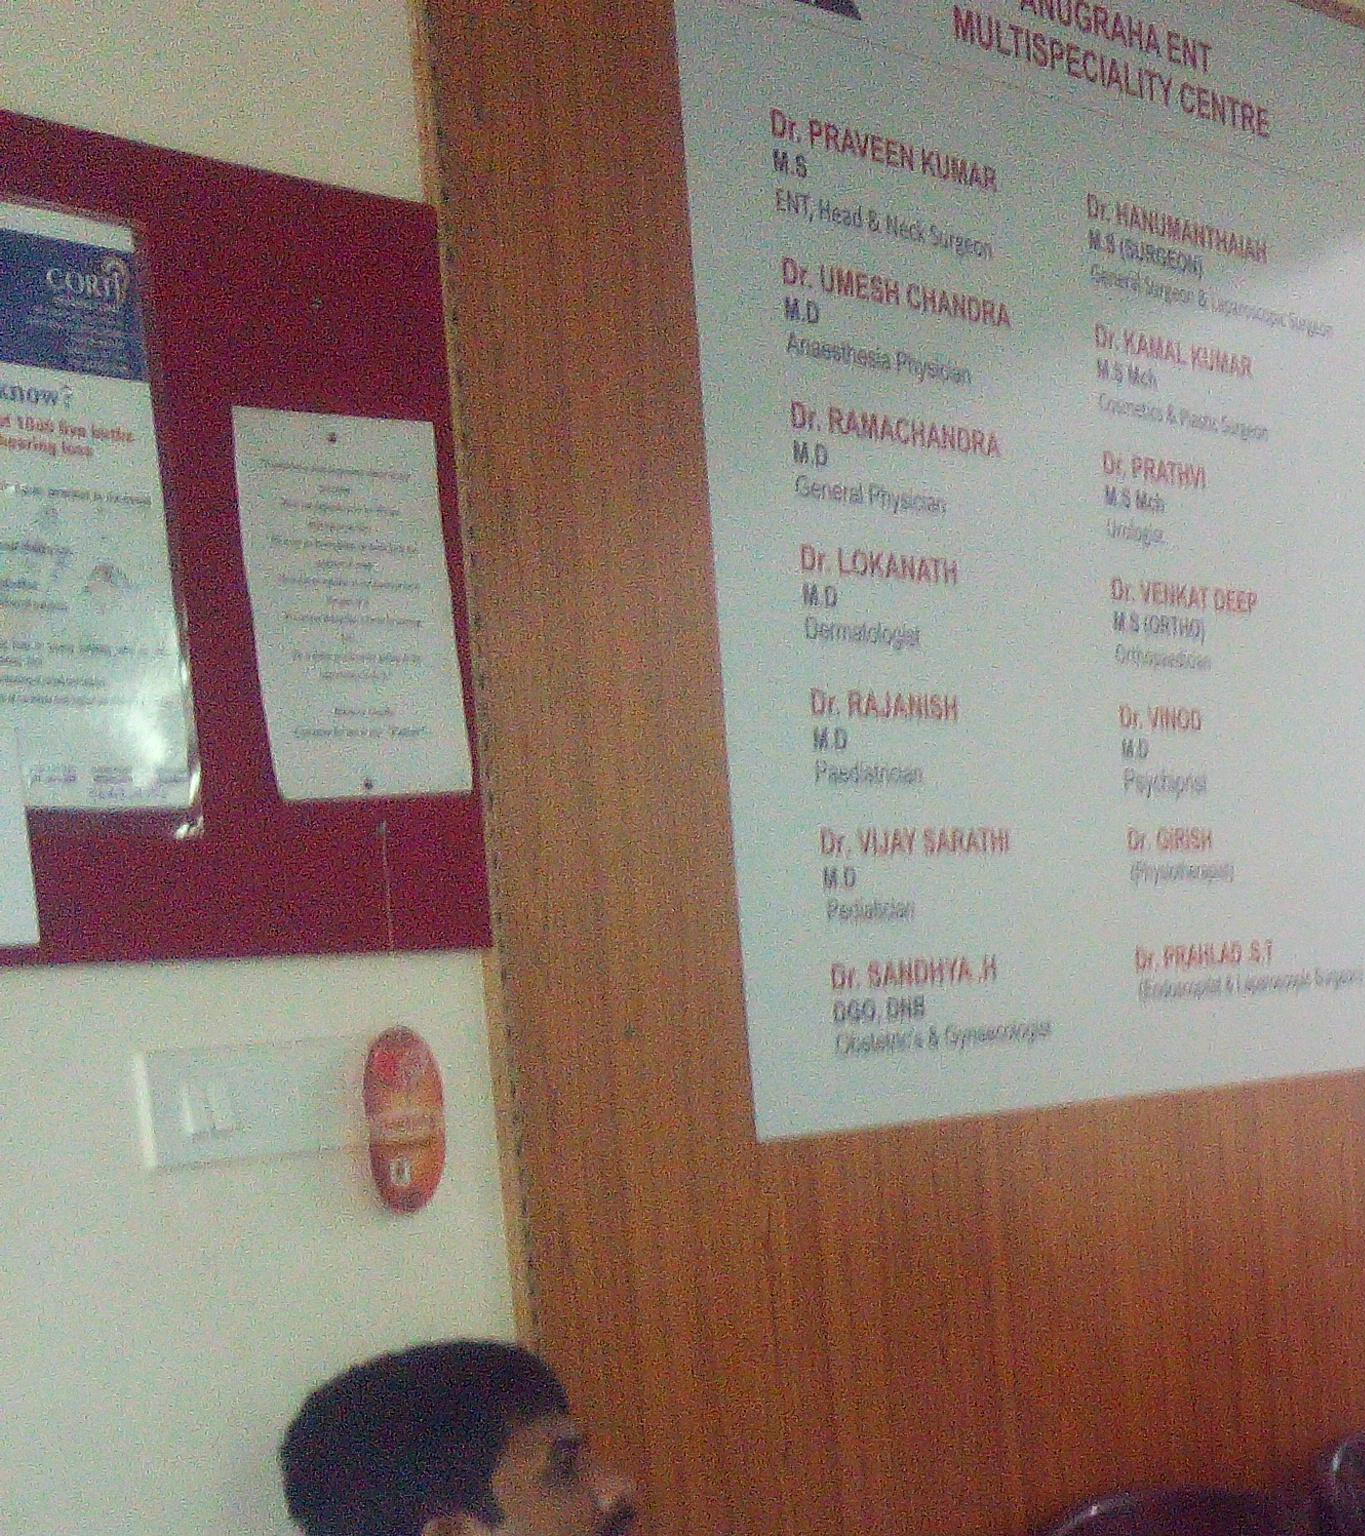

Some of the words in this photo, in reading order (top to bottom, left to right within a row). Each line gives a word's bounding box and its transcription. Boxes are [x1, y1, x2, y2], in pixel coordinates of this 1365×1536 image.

[953, 6, 1172, 106] MULTISPECIALITY
[1180, 82, 1270, 138] CENTRE
[1167, 30, 1211, 74] ENT
[770, 108, 800, 143] Dr.
[809, 119, 914, 171] PRAVEEN
[921, 149, 997, 193] KUMAR
[775, 189, 813, 223] ENT,
[819, 199, 862, 228] Head
[869, 210, 880, 232] &
[886, 216, 924, 243] Neck
[930, 225, 993, 261] Surgeon
[1087, 192, 1110, 221] Dr.
[1115, 201, 1268, 265] HANUMANTHAIAH
[782, 256, 812, 289] Dr.
[821, 264, 900, 305] UMESH
[906, 283, 1012, 328] CHANDRA
[784, 297, 819, 324] M.D
[1095, 323, 1121, 351] Dr.
[1123, 327, 1188, 366] KAMAL
[1191, 344, 1254, 378] KUMAR
[790, 400, 822, 432] Dr.
[827, 406, 1001, 457] RAMACHANDRA
[795, 475, 864, 505] General
[838, 547, 959, 586] LOKANATH
[1140, 580, 1209, 612] VENKAT
[1214, 587, 1258, 615] DEEP
[810, 687, 840, 716] Dr.
[848, 689, 960, 722] RAJANISH
[1118, 704, 1143, 730] Dr.
[1147, 706, 1202, 731] VINOD
[819, 826, 851, 857] Dr.
[858, 827, 916, 856] VIJAY
[923, 825, 1010, 856] SARATHI
[830, 961, 860, 990] Dr.
[867, 956, 973, 989] SANDHYA
